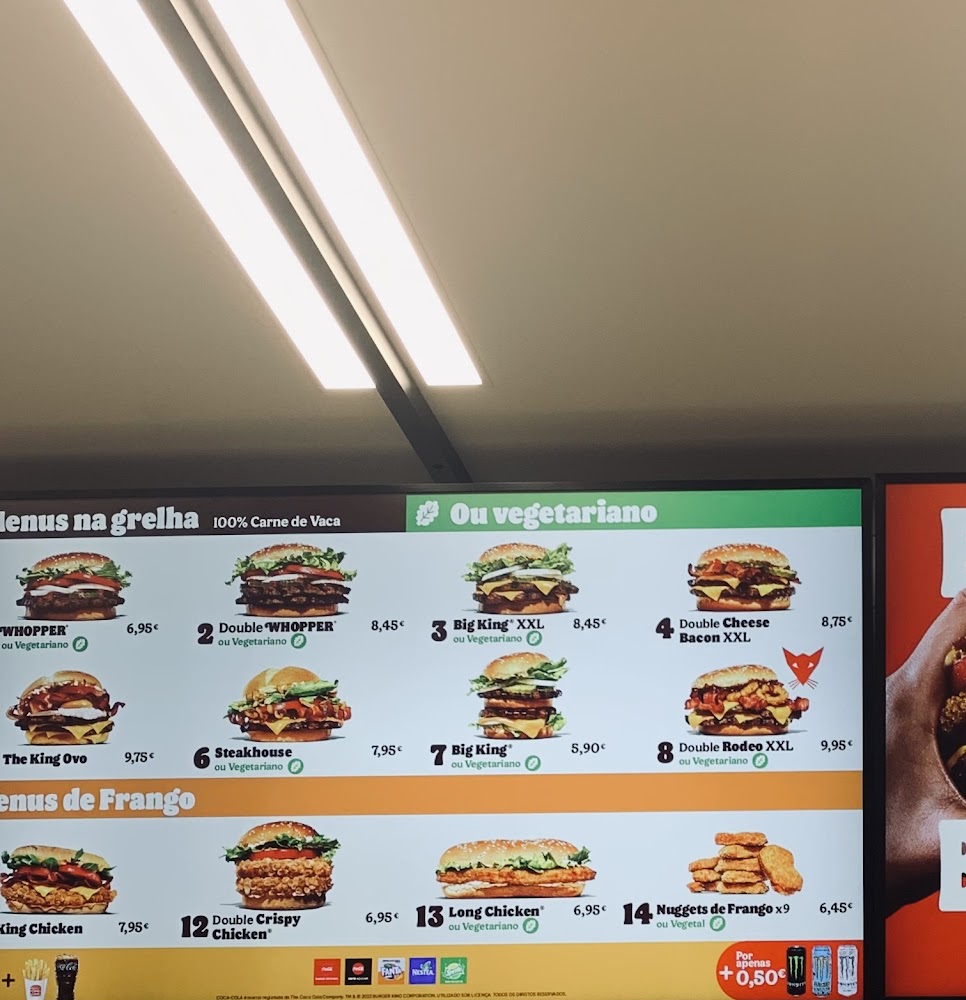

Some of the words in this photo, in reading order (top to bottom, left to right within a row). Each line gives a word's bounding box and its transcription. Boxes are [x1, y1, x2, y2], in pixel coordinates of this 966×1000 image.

[450, 503, 488, 525] Ou
[493, 499, 658, 530] vegetariano
[0, 511, 68, 532] enus
[73, 513, 107, 530] na
[110, 506, 200, 536] grelha
[214, 517, 248, 528] 100%
[251, 516, 289, 527] Carne
[291, 516, 307, 527] de
[310, 515, 340, 526] Vaca
[219, 622, 263, 633] Double
[372, 620, 404, 632] 8,45€
[454, 619, 475, 633] Big
[517, 619, 544, 629] XXL
[574, 619, 606, 630] 8,45€
[656, 617, 674, 639] 4
[680, 619, 719, 628] Double
[723, 617, 769, 628] Cheese
[822, 616, 852, 628] 8,75€
[127, 623, 158, 635] 6,95€
[198, 623, 213, 644] 2
[431, 621, 447, 641] 3
[232, 637, 286, 647] Vegetariano
[467, 634, 522, 645] Vegetariano
[680, 633, 720, 643] Bacon
[723, 632, 750, 642] XXL
[15, 641, 68, 651] Vegetariano
[372, 745, 402, 757] 7,95€
[452, 744, 473, 758] Big
[572, 743, 605, 755] 5,90€
[680, 742, 719, 752] Double
[723, 741, 763, 751] Rodeo
[766, 741, 793, 751] XXL
[821, 740, 852, 752] 9,95€
[125, 752, 154, 764] 9,75€
[194, 747, 210, 769] 6
[215, 747, 292, 758] Steakhouse
[431, 745, 446, 765] 7
[657, 742, 673, 763] 8
[3, 754, 27, 764] The
[30, 753, 61, 767] King
[63, 753, 87, 764] Ovo
[465, 760, 521, 770] Vegetariano
[693, 757, 748, 767] Vegetariano
[228, 762, 283, 773] Vegetariano
[0, 794, 58, 812] enus
[63, 788, 95, 811] de
[99, 788, 195, 817] Frango
[449, 907, 482, 920] Long
[574, 905, 606, 917] 6,95€
[623, 903, 653, 924] 14
[657, 905, 708, 917] Nuggets
[711, 903, 725, 914] de
[728, 904, 773, 917] Frango
[776, 904, 789, 913] x9
[820, 903, 852, 914] 6,45€
[213, 915, 253, 925] Double
[256, 913, 301, 927] Crispy
[366, 912, 398, 924] 6,95€
[416, 905, 444, 927] 13
[29, 922, 82, 934] Chicken
[119, 922, 148, 934] 7,95€
[181, 916, 209, 937] 12
[462, 922, 518, 932] Vegetariano
[671, 919, 705, 930] Vegetal
[736, 951, 754, 963] Por
[736, 959, 770, 969] apenas
